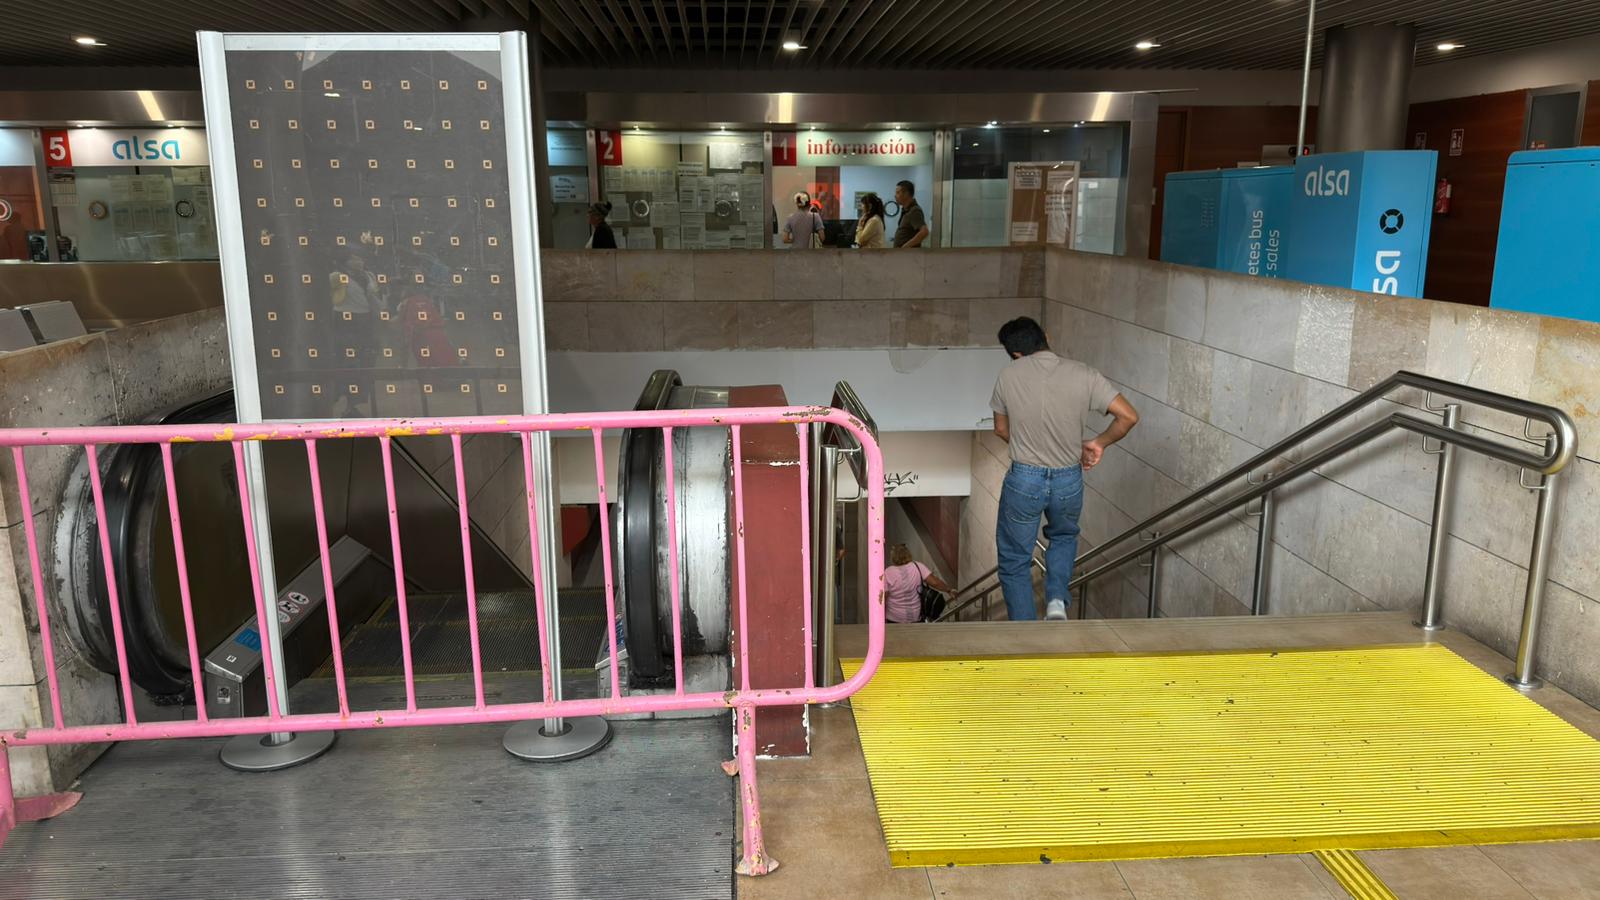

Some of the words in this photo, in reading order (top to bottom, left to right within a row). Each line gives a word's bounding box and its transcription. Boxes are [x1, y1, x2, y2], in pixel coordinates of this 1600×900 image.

[49, 136, 66, 161] 5
[112, 135, 181, 160] alsa
[603, 136, 615, 160] 2
[779, 137, 788, 160] 1
[806, 137, 916, 155] información
[1304, 164, 1351, 197] alsa
[1248, 209, 1264, 239] bus
[1266, 229, 1280, 271] sales
